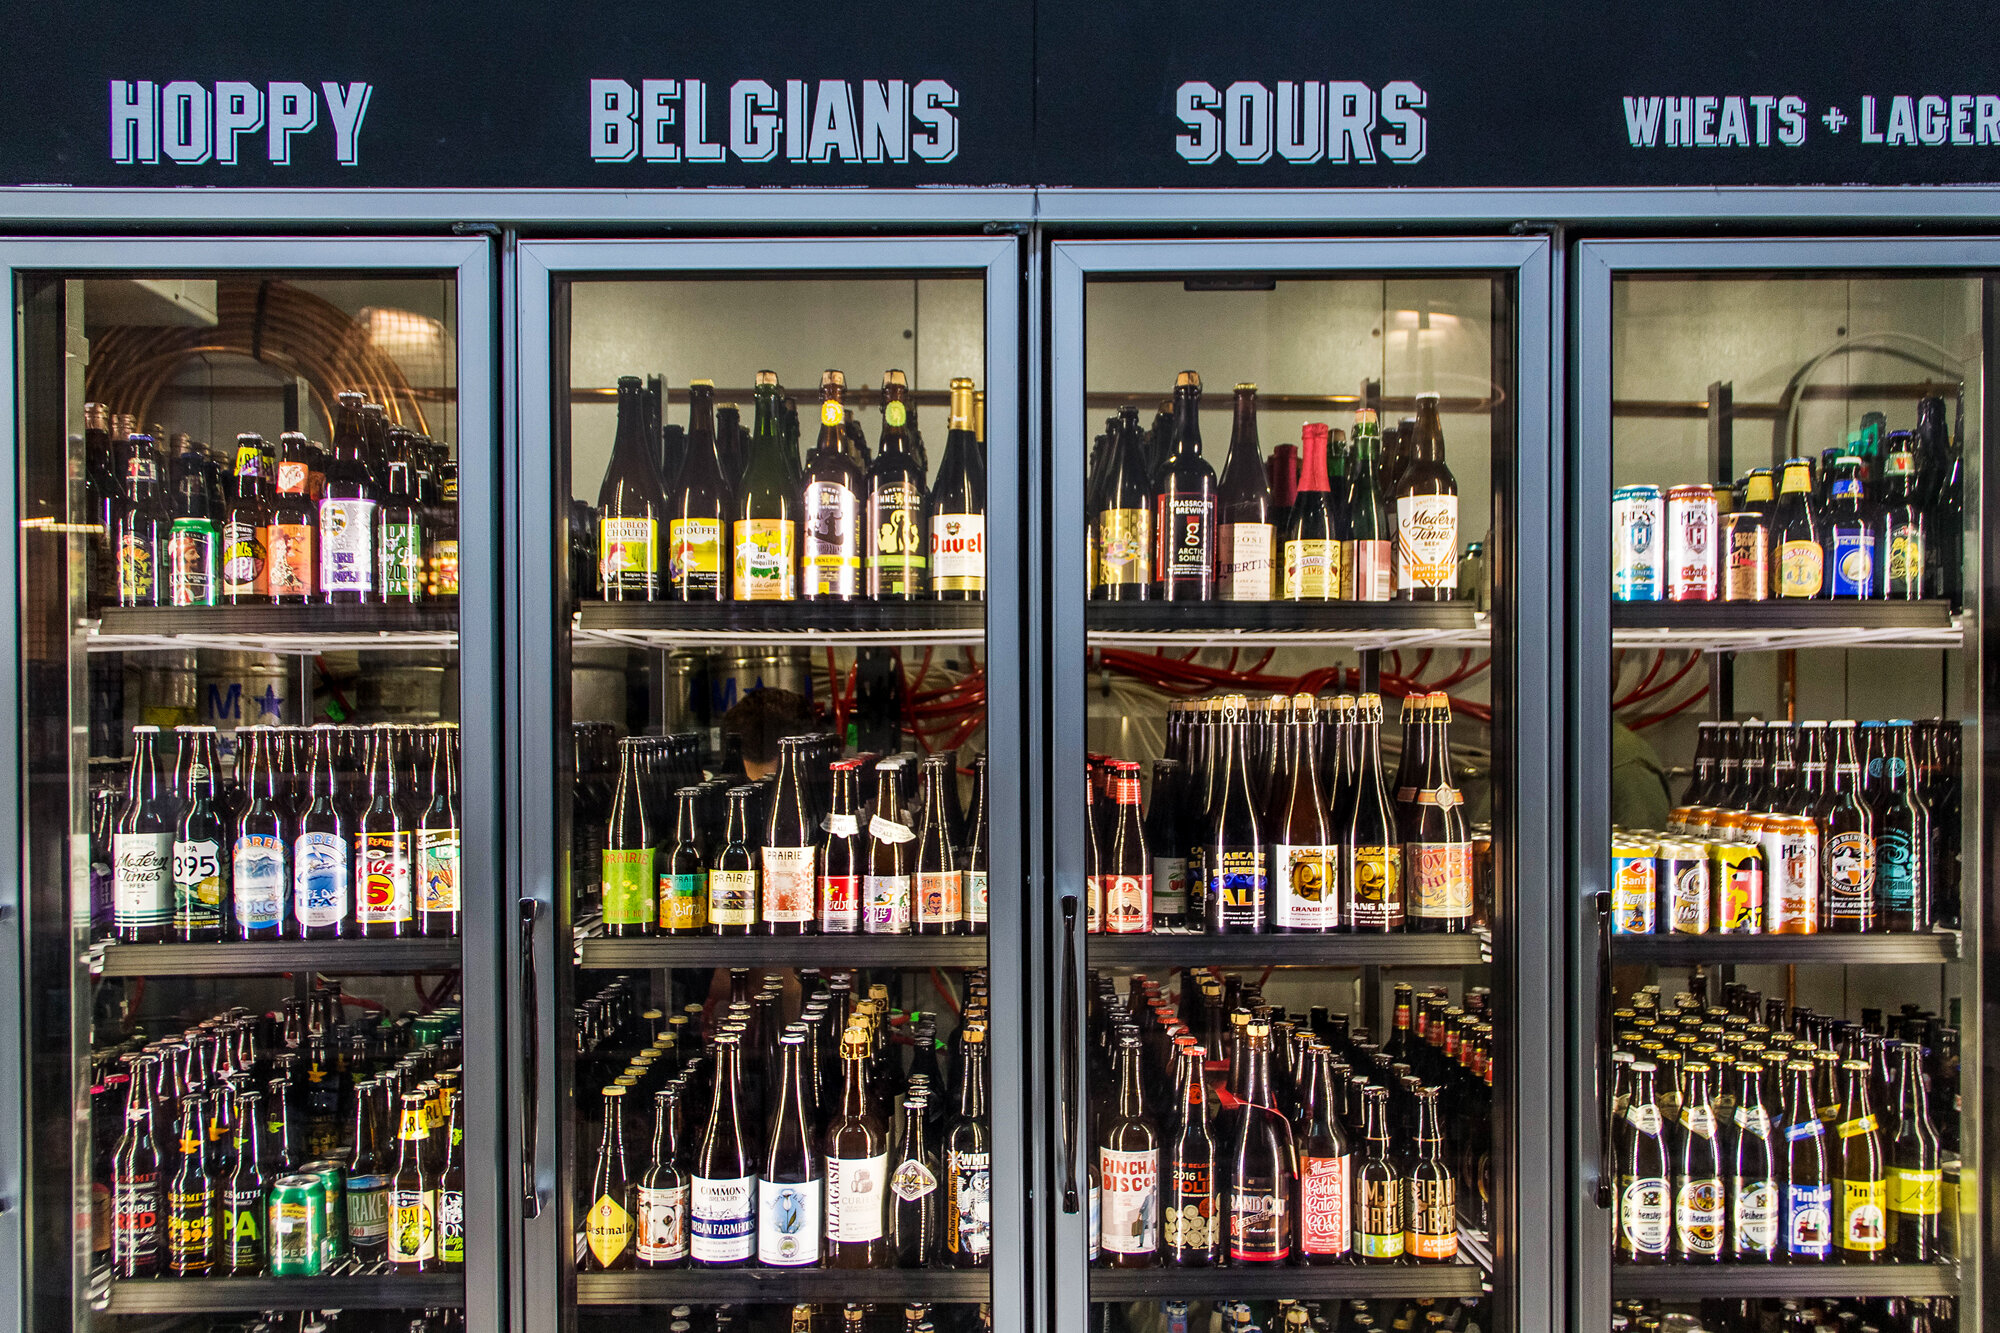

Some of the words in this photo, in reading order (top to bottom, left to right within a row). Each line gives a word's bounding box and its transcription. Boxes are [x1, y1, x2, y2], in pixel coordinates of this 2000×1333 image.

[110, 80, 373, 166] HOPPY
[590, 79, 958, 163] BELGIANS
[1176, 81, 1427, 165] SOURS
[1623, 95, 1806, 147] WHEATS
[1402, 509, 1456, 531] Modern
[673, 527, 719, 536] CHOUFFE
[931, 532, 982, 554] Duvel
[116, 850, 169, 871] Modern
[606, 851, 649, 866] PRAIRIE
[767, 850, 803, 860] PRAIRIE
[118, 868, 162, 882] Times
[173, 855, 216, 877] 395
[674, 875, 703, 883] PRAIRIE
[714, 873, 754, 884] PRAIRIE
[366, 881, 390, 904] 5
[1216, 888, 1265, 906] ALE
[673, 900, 701, 917] Birra
[1172, 1170, 1196, 1181] 2016
[701, 1186, 746, 1196] COMMONS
[1307, 1176, 1342, 1197] Golden
[829, 1160, 841, 1239] ALLAGASH
[117, 1212, 156, 1230] RED
[223, 1210, 257, 1242] PA
